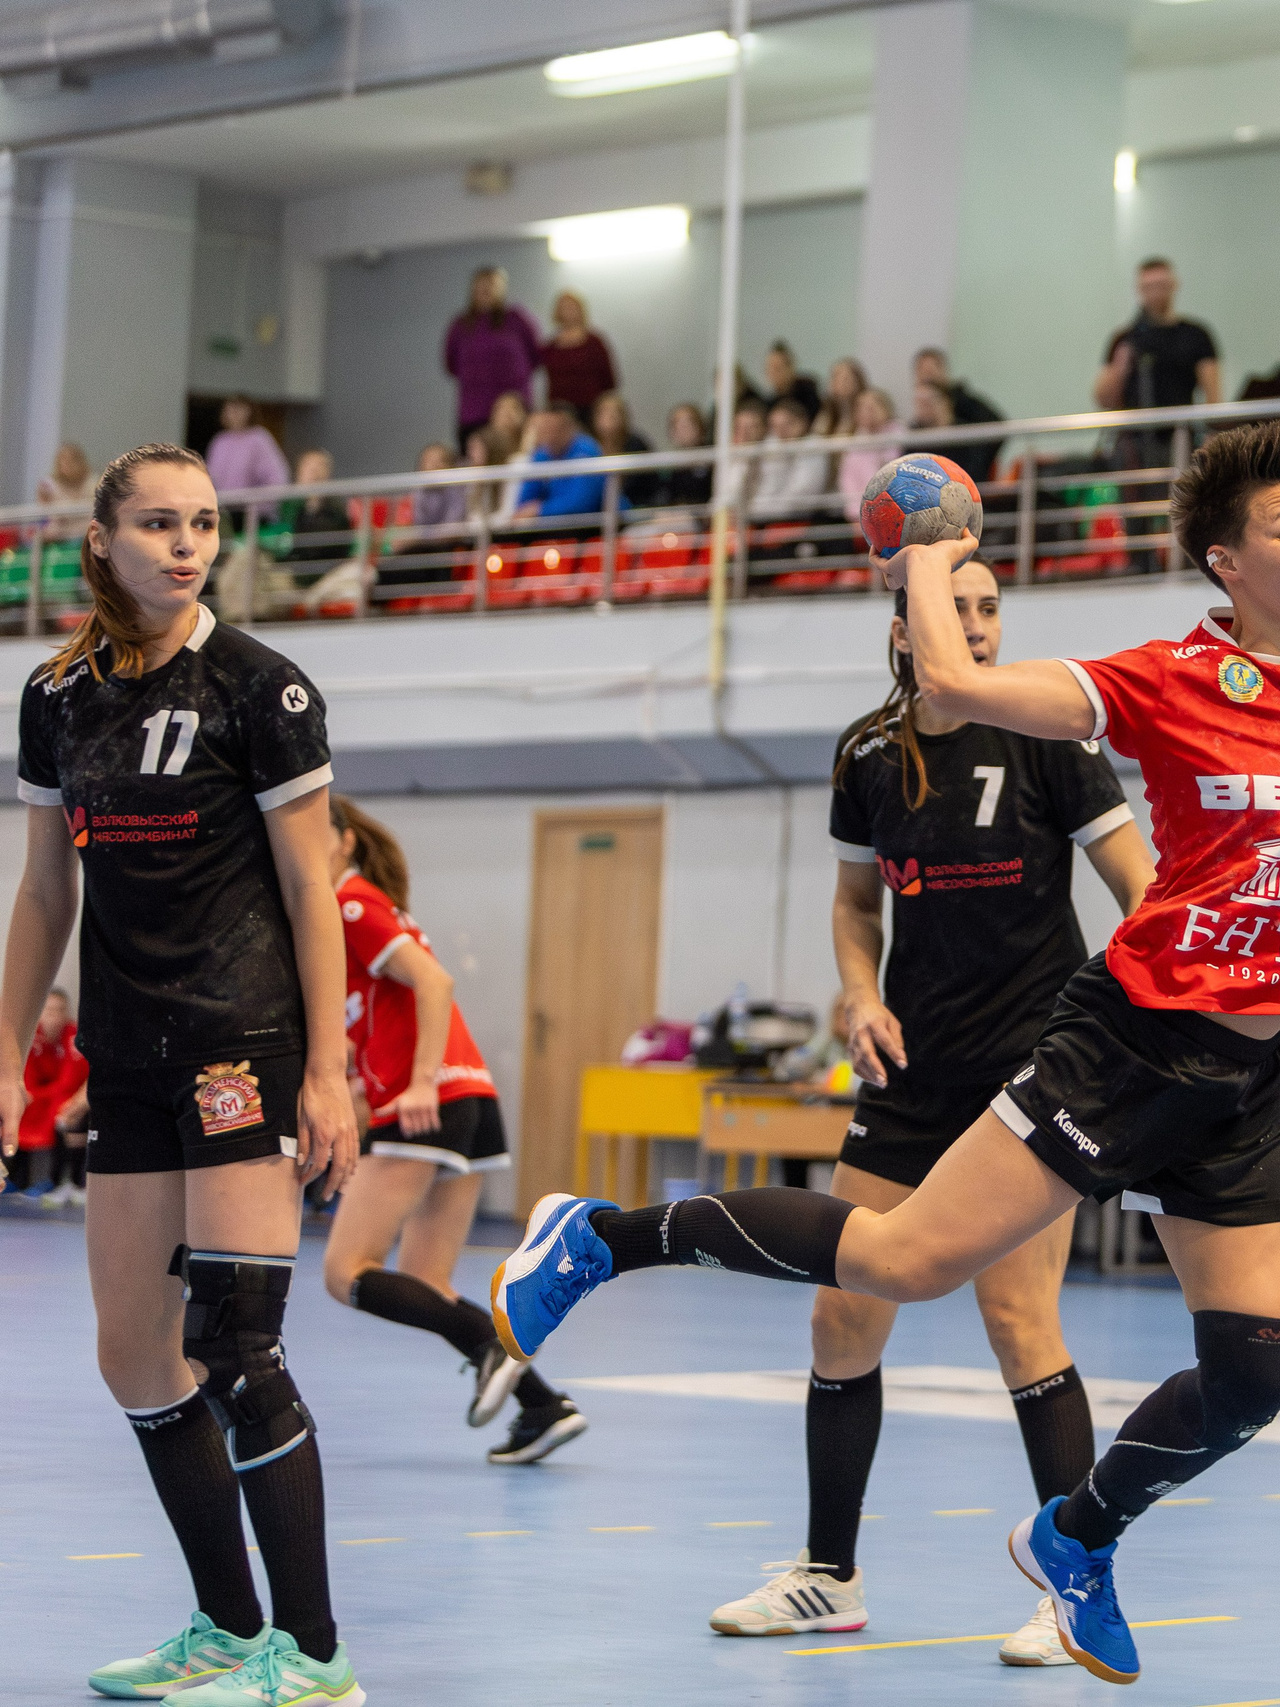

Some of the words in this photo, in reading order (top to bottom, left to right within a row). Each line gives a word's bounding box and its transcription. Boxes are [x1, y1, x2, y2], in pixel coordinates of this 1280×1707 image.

[140, 709, 199, 776] 17
[973, 766, 1005, 827] 7
[1053, 1108, 1100, 1157] Kempa
[1012, 1374, 1066, 1400] mpa
[131, 1411, 183, 1430] mpa
